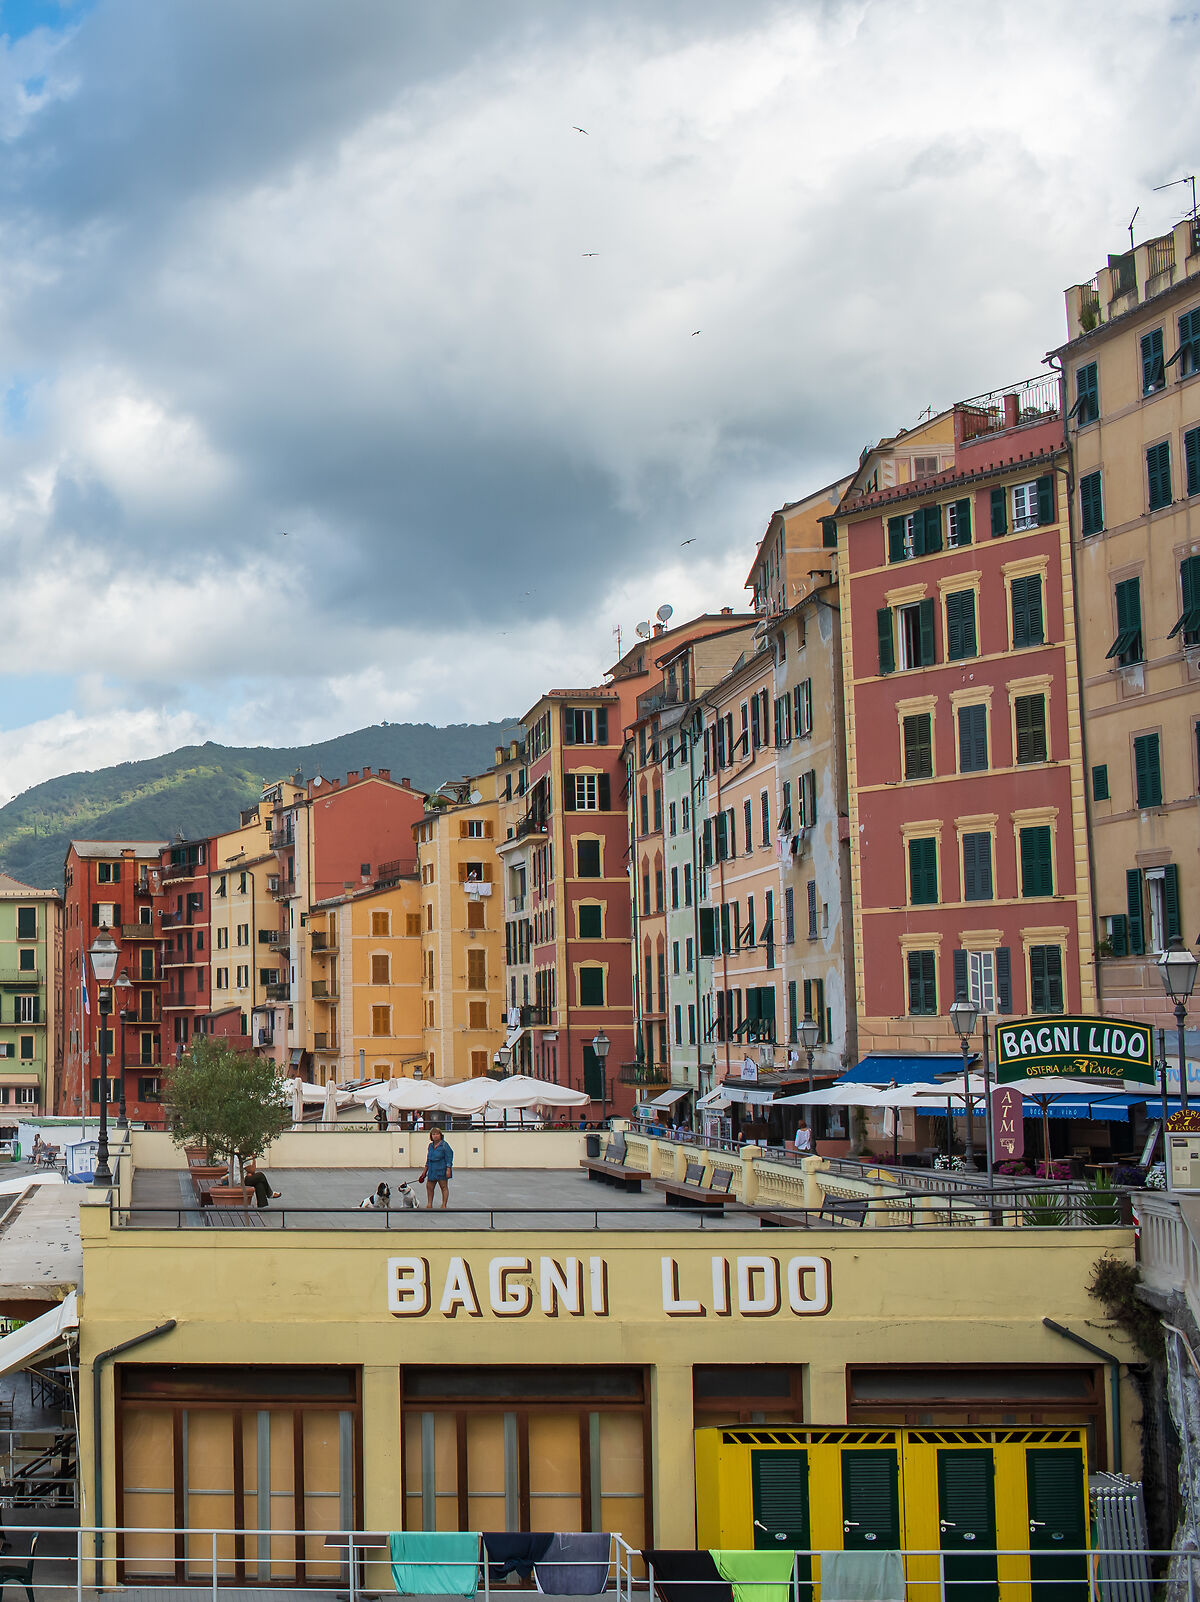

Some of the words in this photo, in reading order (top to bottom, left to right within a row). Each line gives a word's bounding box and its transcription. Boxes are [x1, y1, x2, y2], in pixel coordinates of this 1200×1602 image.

[1002, 1026, 1079, 1058] BAGNI
[1089, 1027, 1146, 1058] LIDO
[1026, 1064, 1060, 1076] OSTERIA
[1089, 1060, 1124, 1077] Pance
[1000, 1091, 1014, 1132] ATM
[1183, 1116, 1193, 1126] 7
[387, 1256, 610, 1318] BAGNI
[661, 1256, 834, 1318] LIDO
